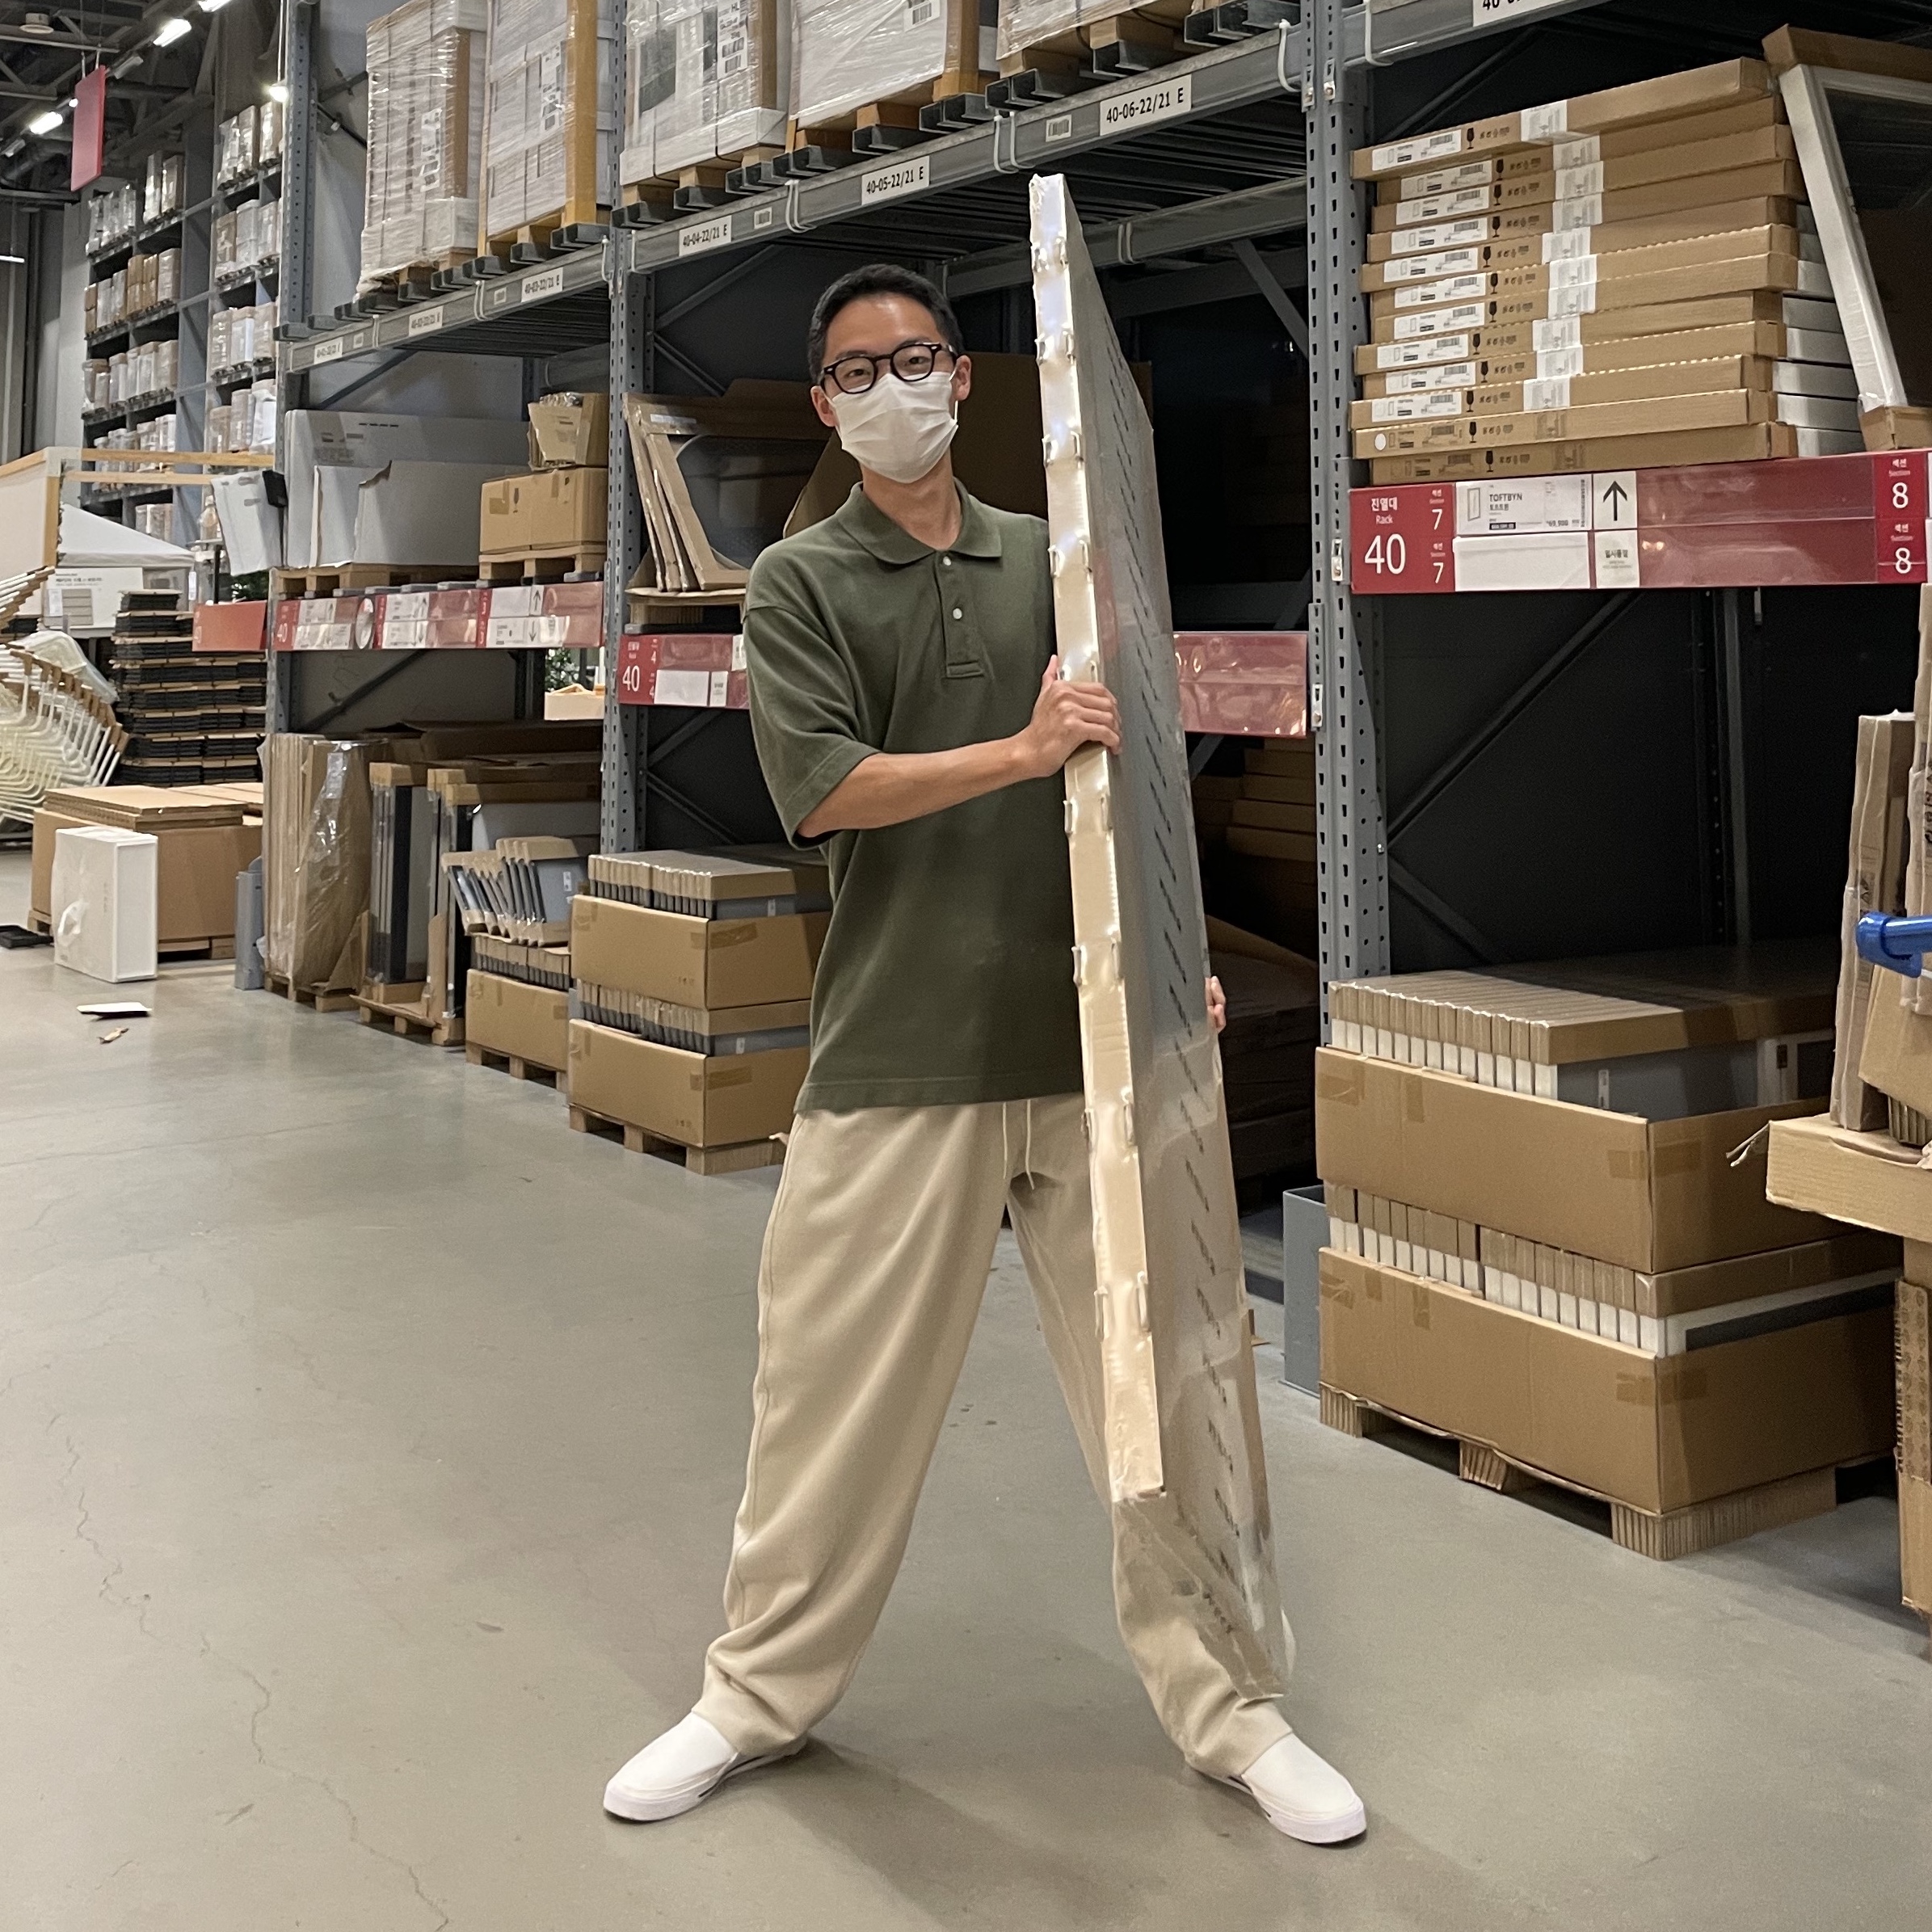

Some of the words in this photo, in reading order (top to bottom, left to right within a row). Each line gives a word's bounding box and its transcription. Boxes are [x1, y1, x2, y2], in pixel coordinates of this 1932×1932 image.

[1106, 91, 1170, 123] 40-06-22/21
[1177, 87, 1184, 103] E
[866, 169, 914, 194] 40-05-22/21
[919, 166, 924, 180] E
[723, 224, 727, 236] E
[1892, 482, 1909, 509] 8
[1431, 508, 1443, 530] 7
[1364, 533, 1406, 575] 40
[1895, 547, 1912, 575] 8
[1433, 562, 1444, 583] 7
[622, 665, 640, 692] 40
